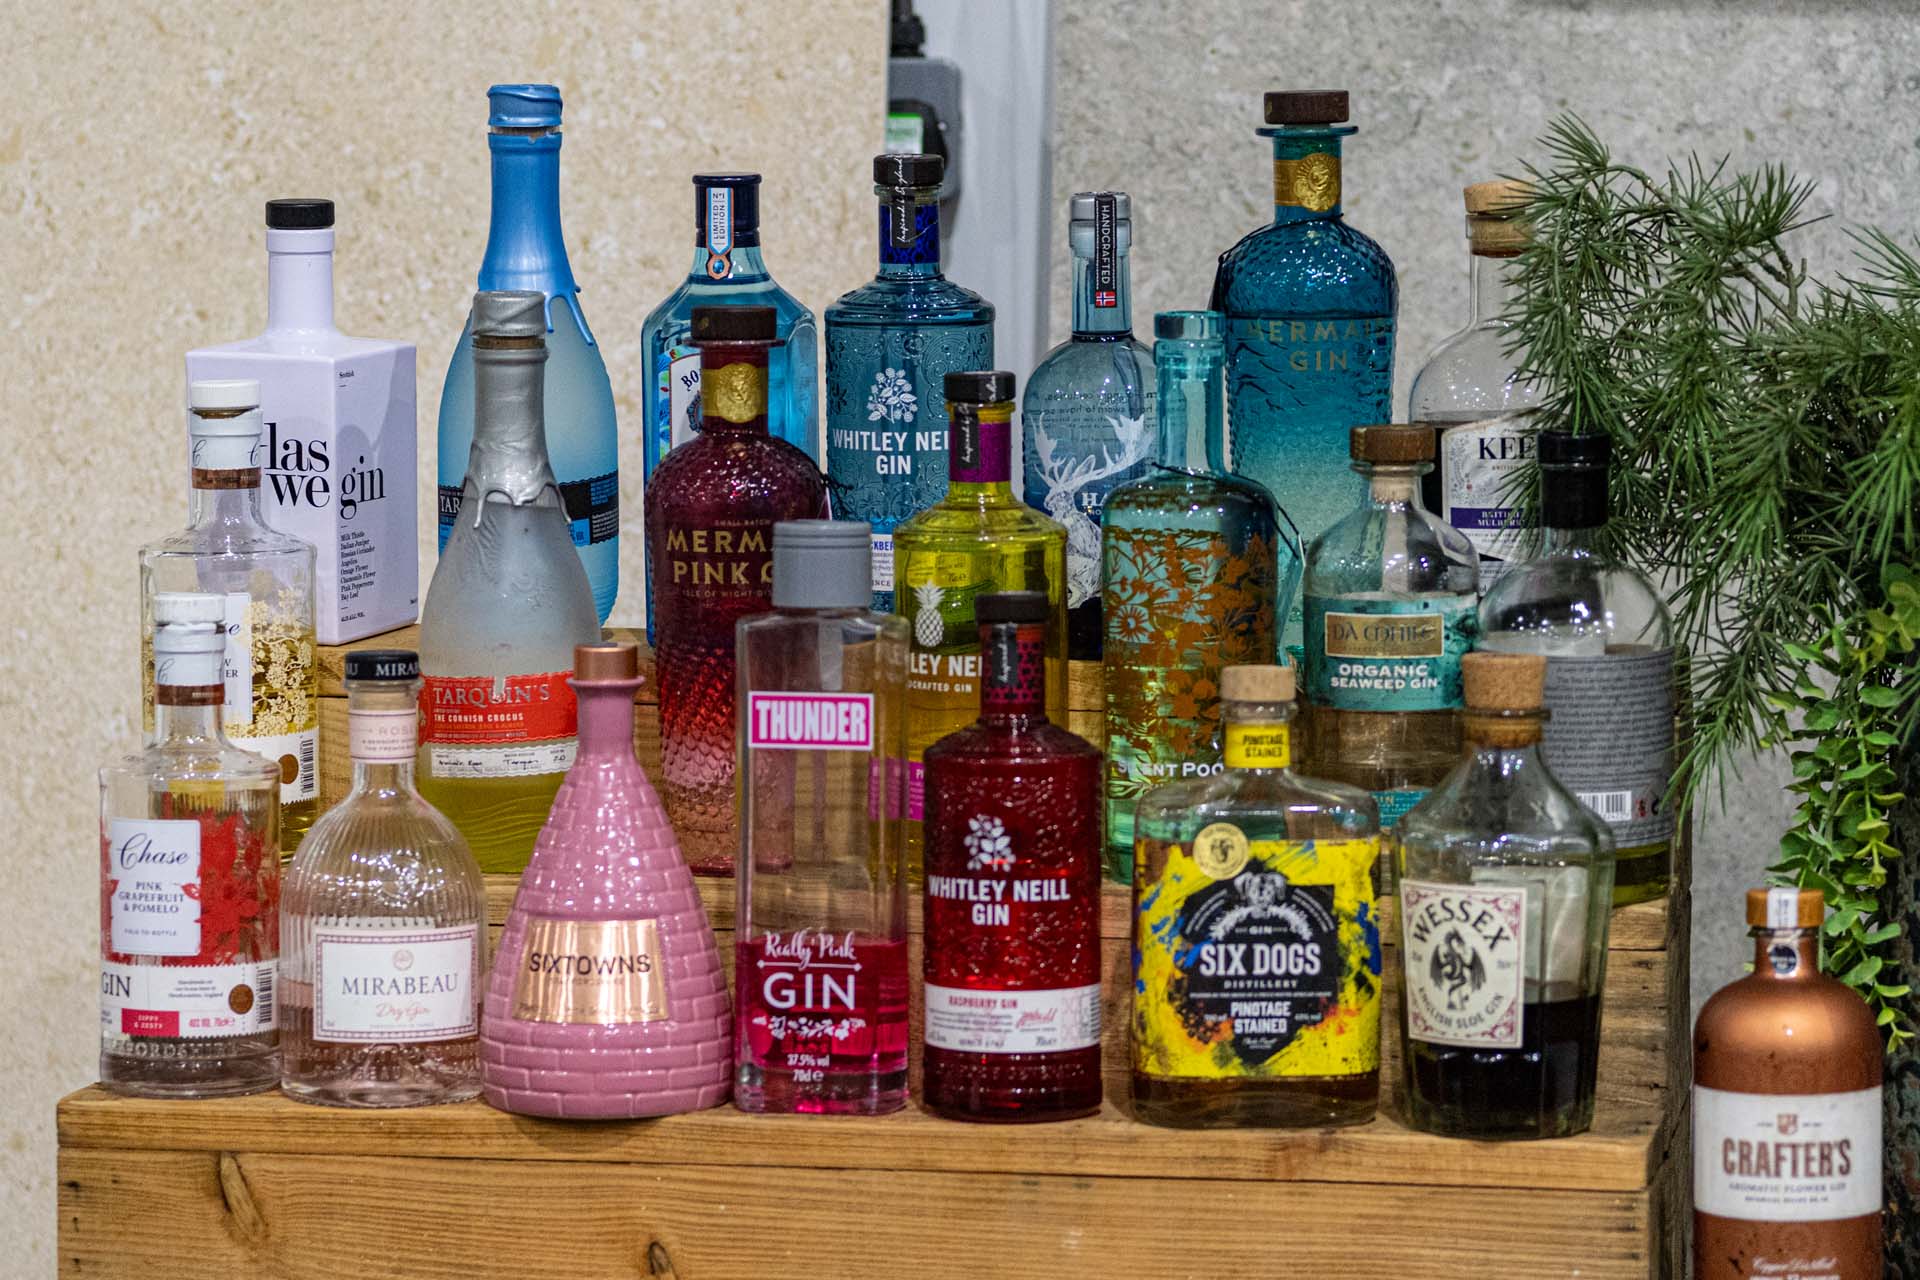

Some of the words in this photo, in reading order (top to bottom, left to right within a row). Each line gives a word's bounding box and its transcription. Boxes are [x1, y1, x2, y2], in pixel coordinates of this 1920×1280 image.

[1101, 204, 1111, 284] HANDCRAFTED
[1288, 350, 1347, 372] GIN
[680, 368, 701, 391] BO
[260, 422, 330, 473] las
[832, 428, 908, 452] WHITLEY
[915, 430, 949, 452] NEI
[875, 455, 911, 475] GIN
[265, 473, 331, 508] we
[340, 455, 387, 520] gin
[666, 529, 773, 553] MERM
[673, 560, 750, 585] PINK
[910, 652, 941, 676] LEY
[948, 654, 983, 677] NEI
[1339, 663, 1428, 677] ORGANIC
[953, 683, 972, 693] GIN
[1330, 676, 1406, 689] SEAWEED
[1410, 677, 1438, 689] GIN
[434, 713, 445, 723] THE
[448, 713, 483, 723] CORNISH
[487, 712, 524, 723] CROCUS
[755, 699, 867, 742] THUNDER
[1242, 734, 1284, 746] PINOTAGE
[1245, 747, 1283, 758] STAINED
[116, 832, 189, 871] Chase
[118, 891, 185, 903] GRAPEFRUIT
[135, 881, 162, 891] PINK
[928, 875, 1006, 902] WHITLEY
[1013, 878, 1071, 902] NEILL
[122, 903, 129, 912] &
[132, 903, 180, 914] POMELO
[971, 903, 1010, 927] GIN
[1413, 897, 1511, 951] WESSEX
[764, 927, 813, 971] Really
[818, 926, 857, 960] Pink
[1199, 942, 1247, 977] SIX
[1252, 942, 1321, 976] DOGS
[529, 952, 652, 976] SIXTOWNS
[101, 971, 131, 998] GIN
[341, 973, 459, 997] MIRABEAU
[763, 972, 856, 1010] GIN
[1223, 979, 1298, 989] DISTILLERY
[1001, 999, 1018, 1009] GIN
[1230, 1001, 1292, 1017] PINOTAGE
[1455, 1014, 1485, 1029] SLOE
[1485, 993, 1505, 1015] GIN
[1234, 1018, 1288, 1034] STAINED
[1721, 1137, 1852, 1179] CRAFTER'S
